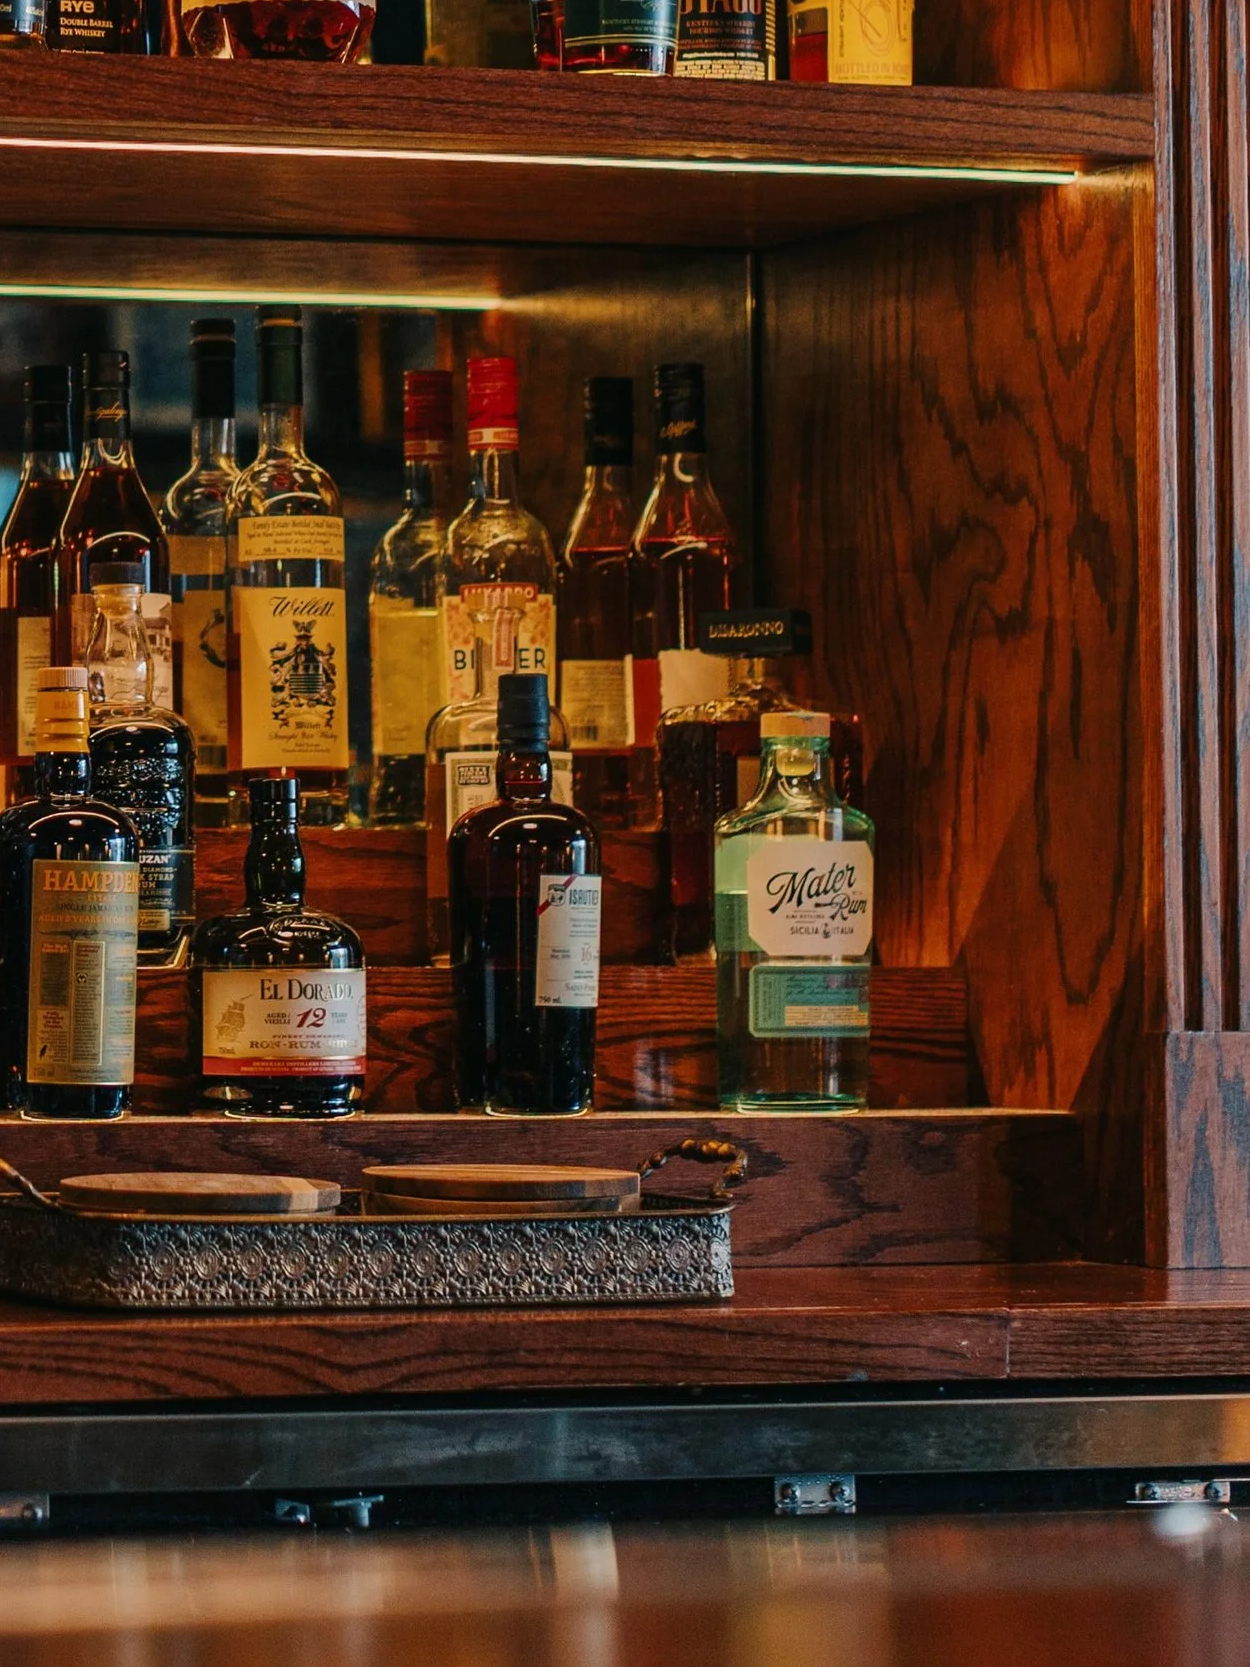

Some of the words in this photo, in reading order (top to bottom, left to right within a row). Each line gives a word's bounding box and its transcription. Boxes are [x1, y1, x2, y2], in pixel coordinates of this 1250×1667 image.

[60, 0, 95, 13] RYE
[60, 17, 89, 27] DOUBLE
[89, 18, 114, 28] BARREL
[60, 28, 74, 36] RYE
[75, 29, 106, 37] WHISKEY
[269, 596, 335, 618] Willett
[708, 620, 784, 639] DISARONNO
[454, 647, 546, 671] BIER
[138, 855, 170, 865] UZAN
[43, 869, 139, 893] HAMPDEN
[148, 874, 175, 882] STRAP
[767, 862, 856, 914] Mater
[814, 893, 868, 921] Rum
[790, 926, 819, 935] SICILIA
[259, 978, 284, 1001] EL
[287, 978, 353, 1003] DORADO
[295, 1007, 327, 1029] 12
[249, 1040, 281, 1049] RON
[288, 1040, 322, 1049] RUM
